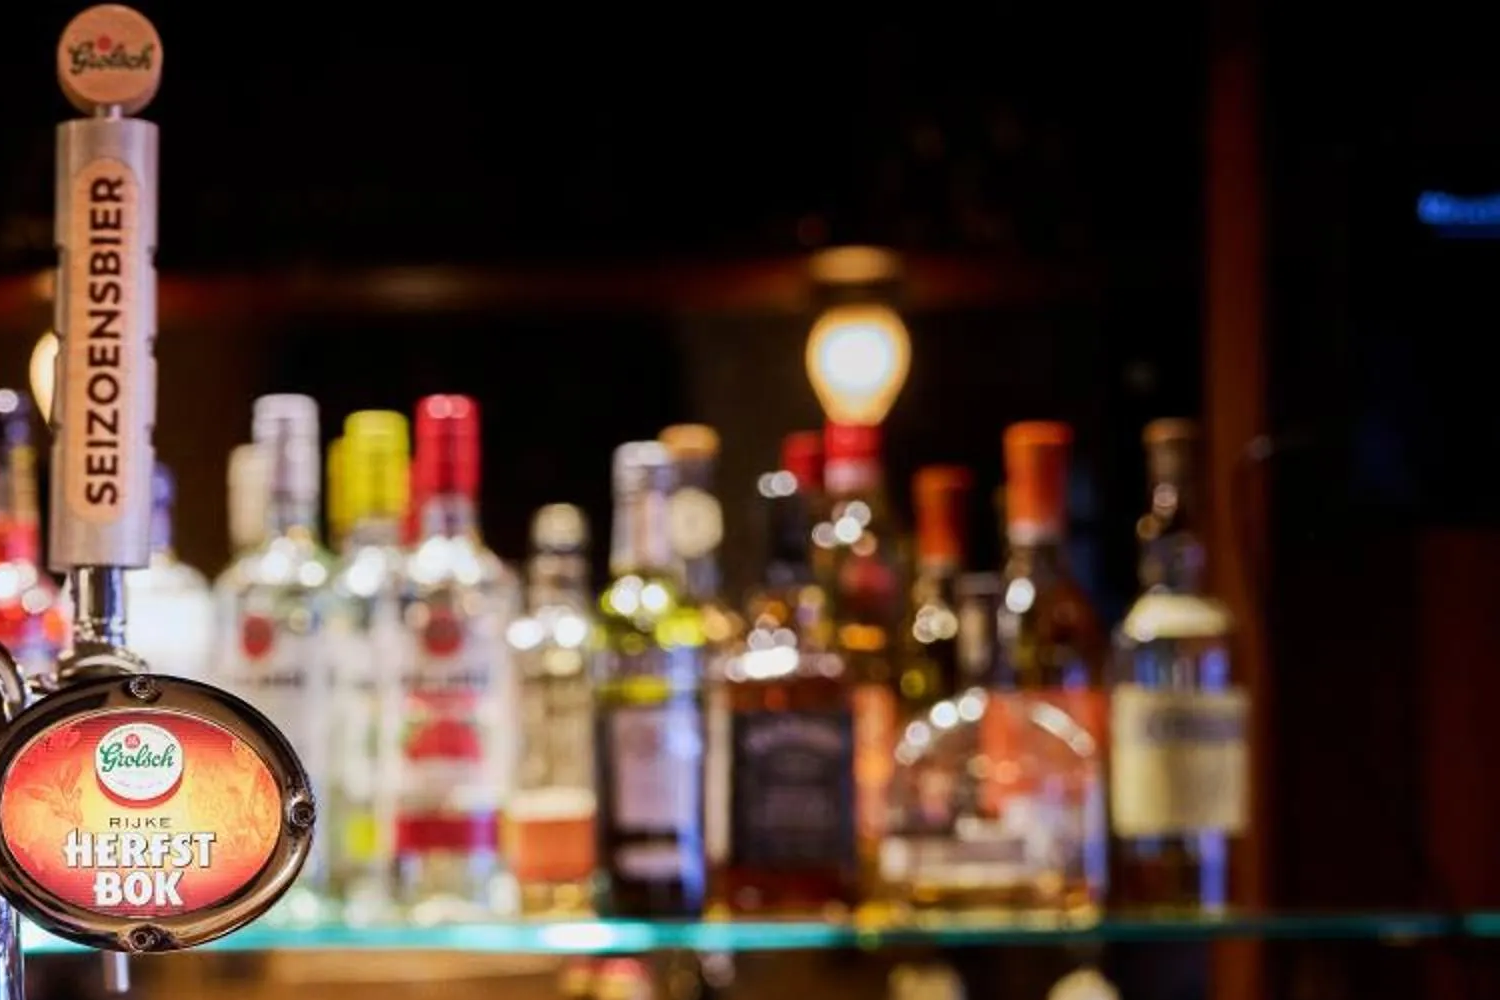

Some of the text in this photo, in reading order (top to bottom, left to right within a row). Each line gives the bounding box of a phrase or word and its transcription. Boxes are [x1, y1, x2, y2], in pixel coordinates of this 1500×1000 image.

[84, 175, 124, 506] SEIZOENSBIER
[100, 742, 177, 773] Grolsch
[108, 817, 172, 829] RIJKE
[63, 829, 217, 868] HERFST
[94, 870, 185, 907] BOK
